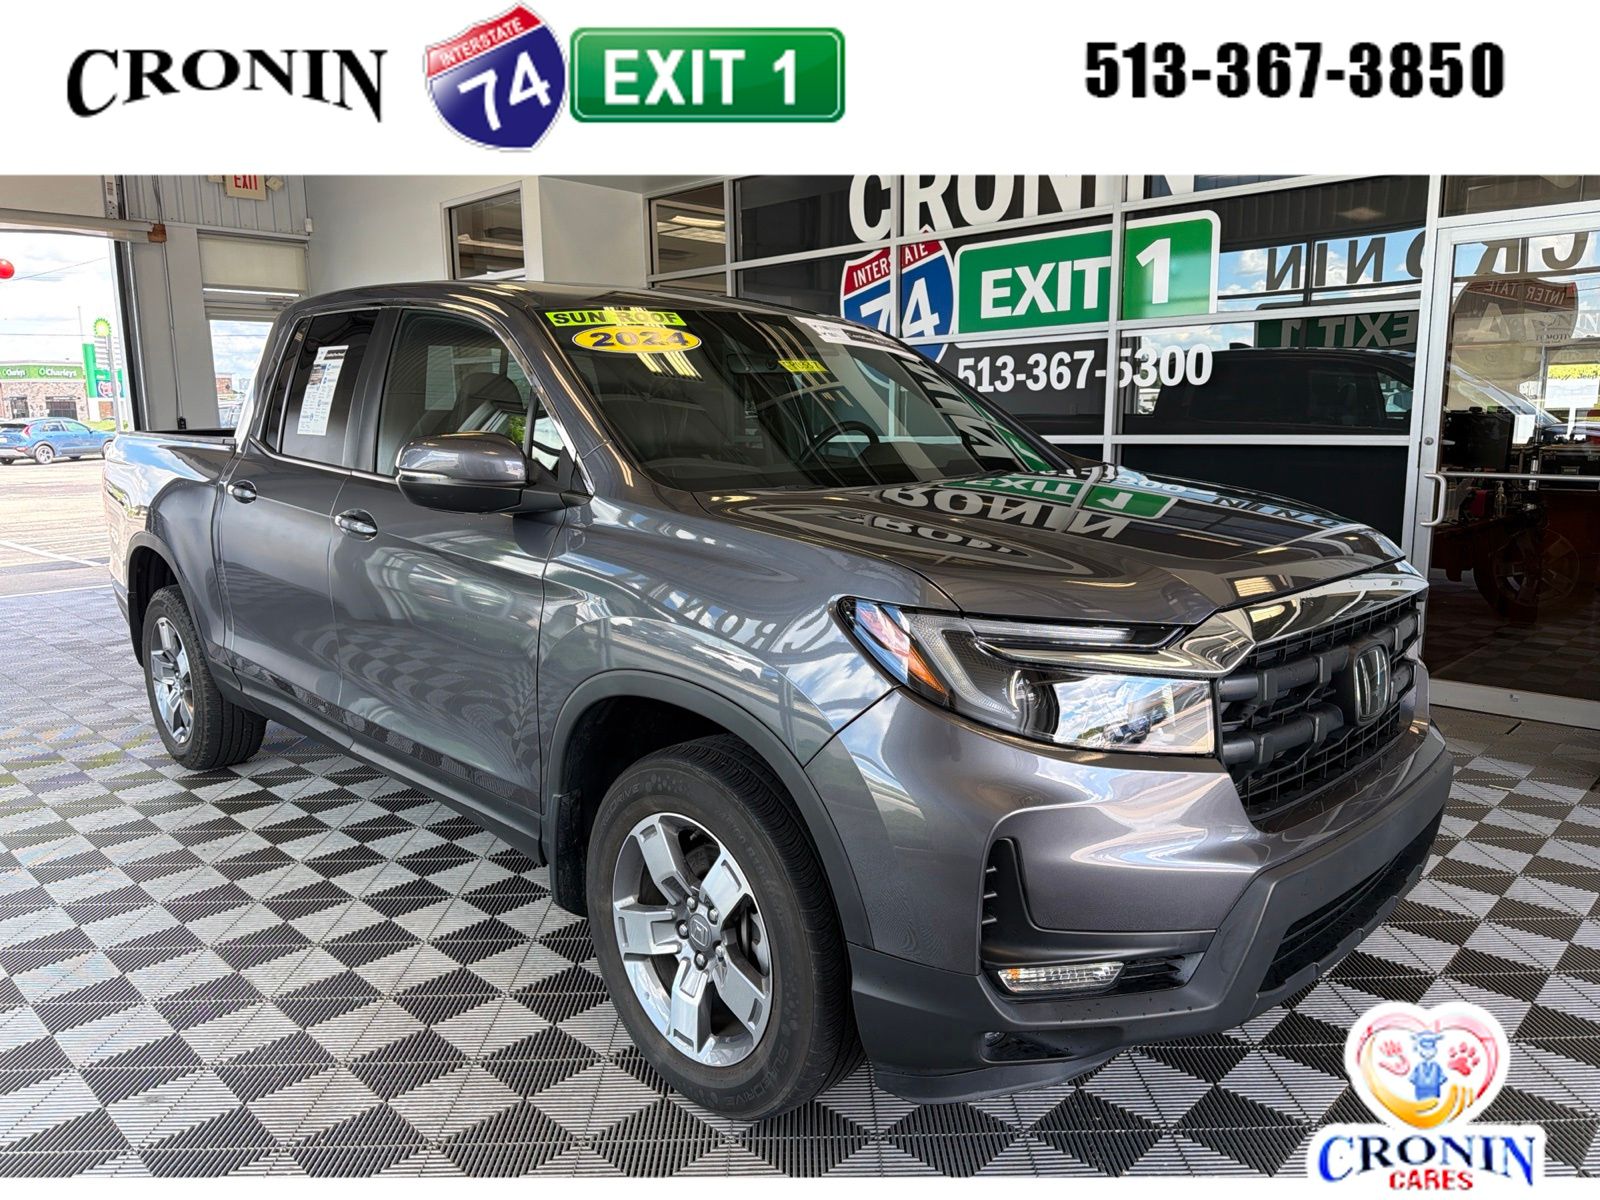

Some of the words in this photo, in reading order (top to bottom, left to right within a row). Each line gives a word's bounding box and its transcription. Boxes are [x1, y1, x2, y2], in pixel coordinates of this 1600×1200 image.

[233, 175, 258, 190] EXIT
[849, 174, 1196, 243] CRON
[853, 243, 929, 288] INTERATE
[980, 256, 1111, 319] EXIT
[1136, 238, 1171, 304] 1
[553, 310, 606, 324] SUN
[617, 311, 679, 324] ROOF
[859, 277, 940, 338] 74
[590, 331, 689, 347] 2024
[957, 344, 1213, 393] 513-367-5300
